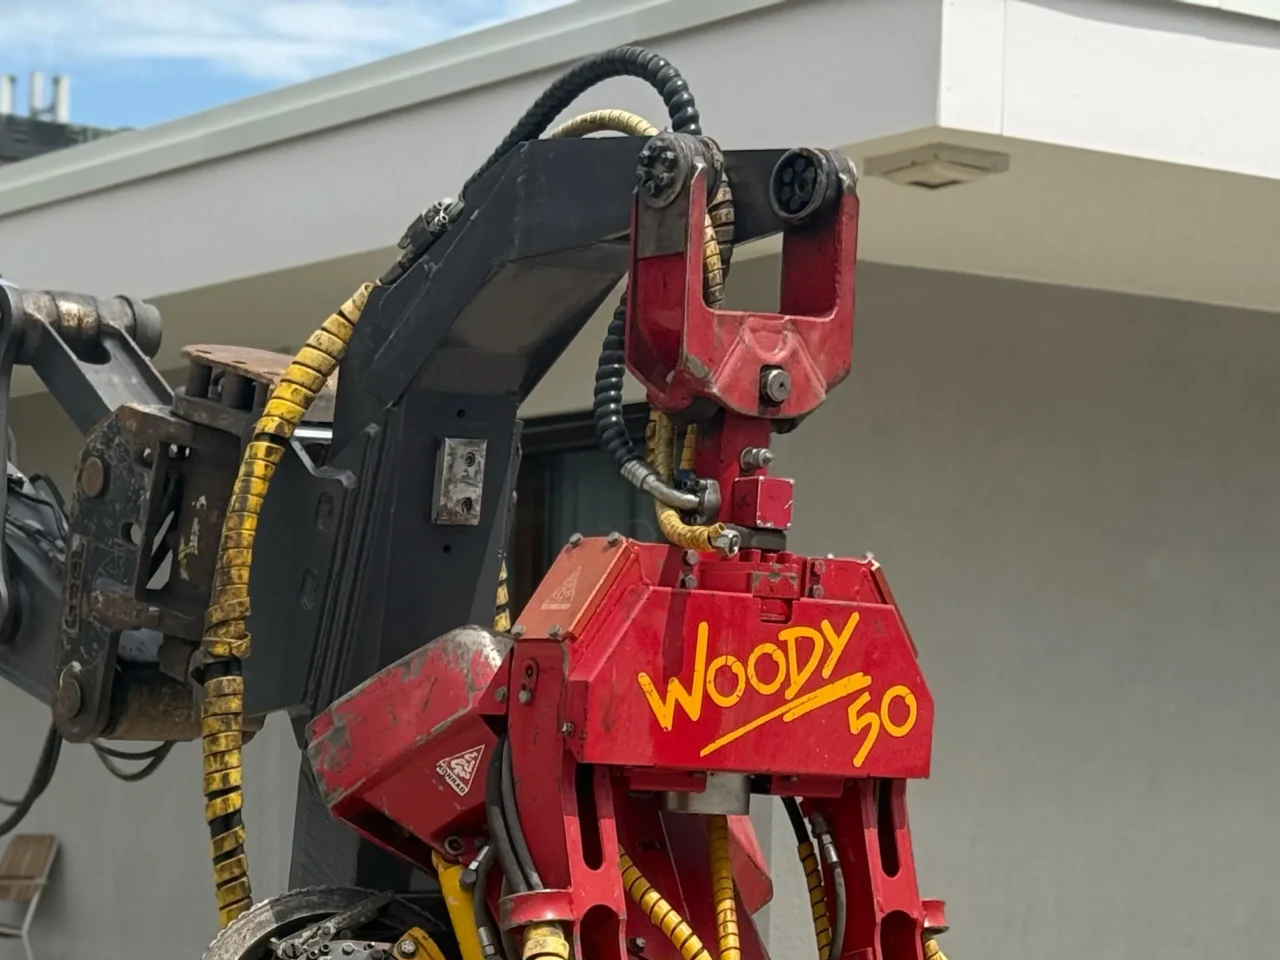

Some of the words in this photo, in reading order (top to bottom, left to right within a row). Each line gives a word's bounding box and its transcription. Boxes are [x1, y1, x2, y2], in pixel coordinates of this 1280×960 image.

[637, 611, 860, 732] WOODY
[847, 685, 917, 768] 50
[437, 762, 466, 794] KONRAD
